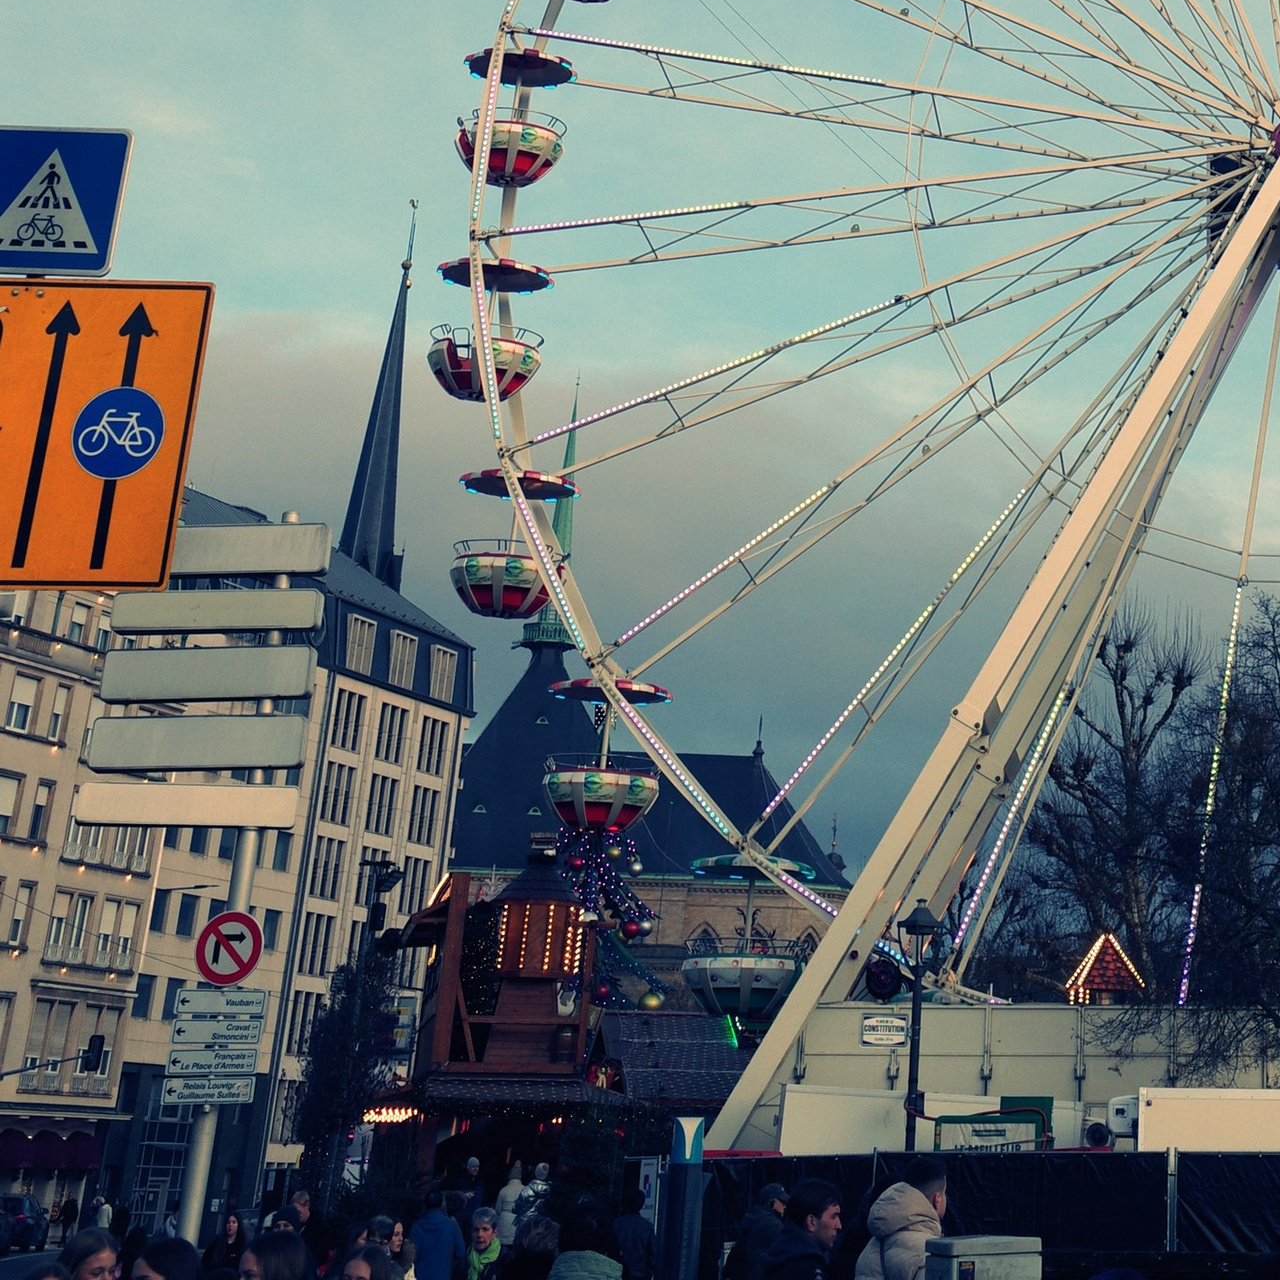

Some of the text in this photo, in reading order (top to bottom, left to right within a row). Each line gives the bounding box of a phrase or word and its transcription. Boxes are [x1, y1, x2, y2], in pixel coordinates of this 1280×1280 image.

[225, 999, 254, 1007] Vauban
[226, 1023, 250, 1031] Cravat
[863, 1024, 905, 1033] CONSTITUTION
[211, 1033, 249, 1041] Simoncini
[213, 1053, 246, 1062] Français
[180, 1062, 245, 1071] Le Place d'Armes
[183, 1082, 206, 1090] Relais
[177, 1091, 240, 1100] Guillaume Suites
